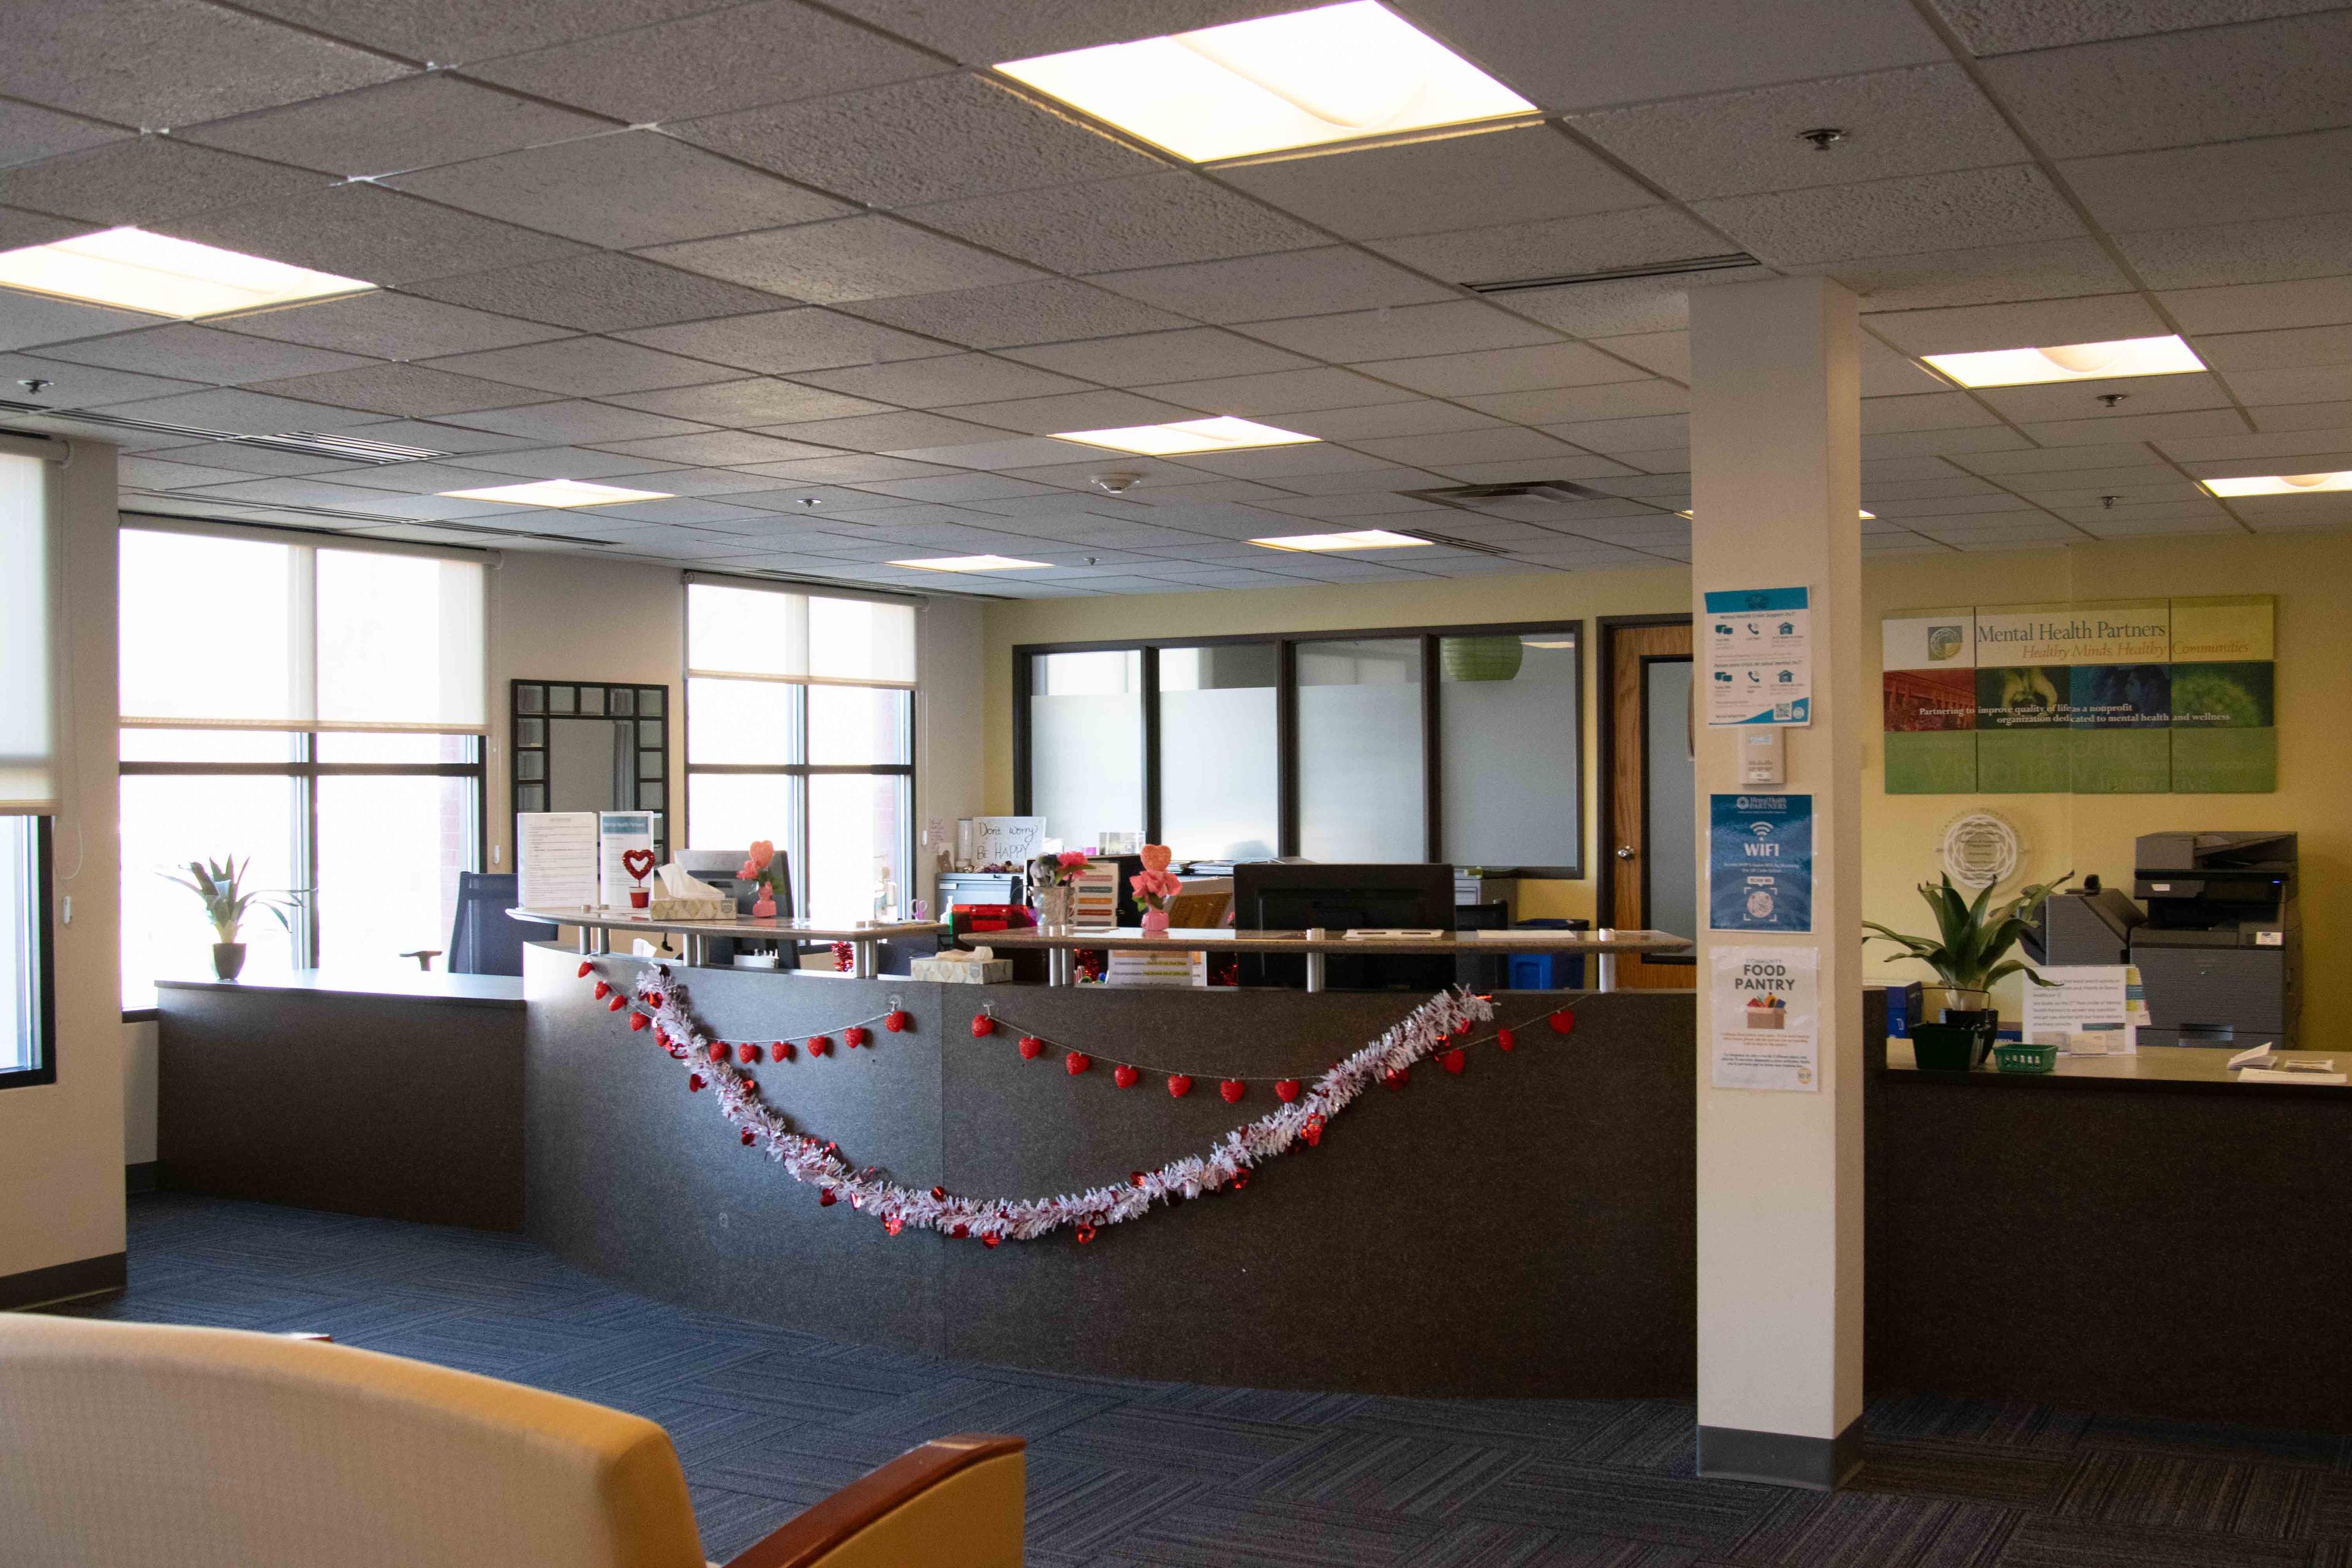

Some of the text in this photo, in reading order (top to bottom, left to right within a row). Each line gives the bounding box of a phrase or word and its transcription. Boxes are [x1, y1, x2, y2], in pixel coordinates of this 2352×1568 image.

[1978, 620, 2166, 643] Mental Health Partners
[2022, 644, 2069, 661] Healthy
[2117, 641, 2166, 658] Healthy
[2172, 640, 2250, 655] Communities
[1919, 707, 1964, 717] Partnering
[1978, 706, 2013, 716] improve
[2015, 705, 2045, 715] quality
[2089, 703, 2132, 714] nonprofit
[1997, 716, 2051, 726] organization
[2190, 712, 2230, 721] wellness
[1009, 824, 1039, 843] worry
[994, 842, 1030, 860] HAPPY
[1744, 843, 1780, 856] WIFI
[1744, 964, 1786, 976] FOOD
[1735, 978, 1795, 990] PANTRY
